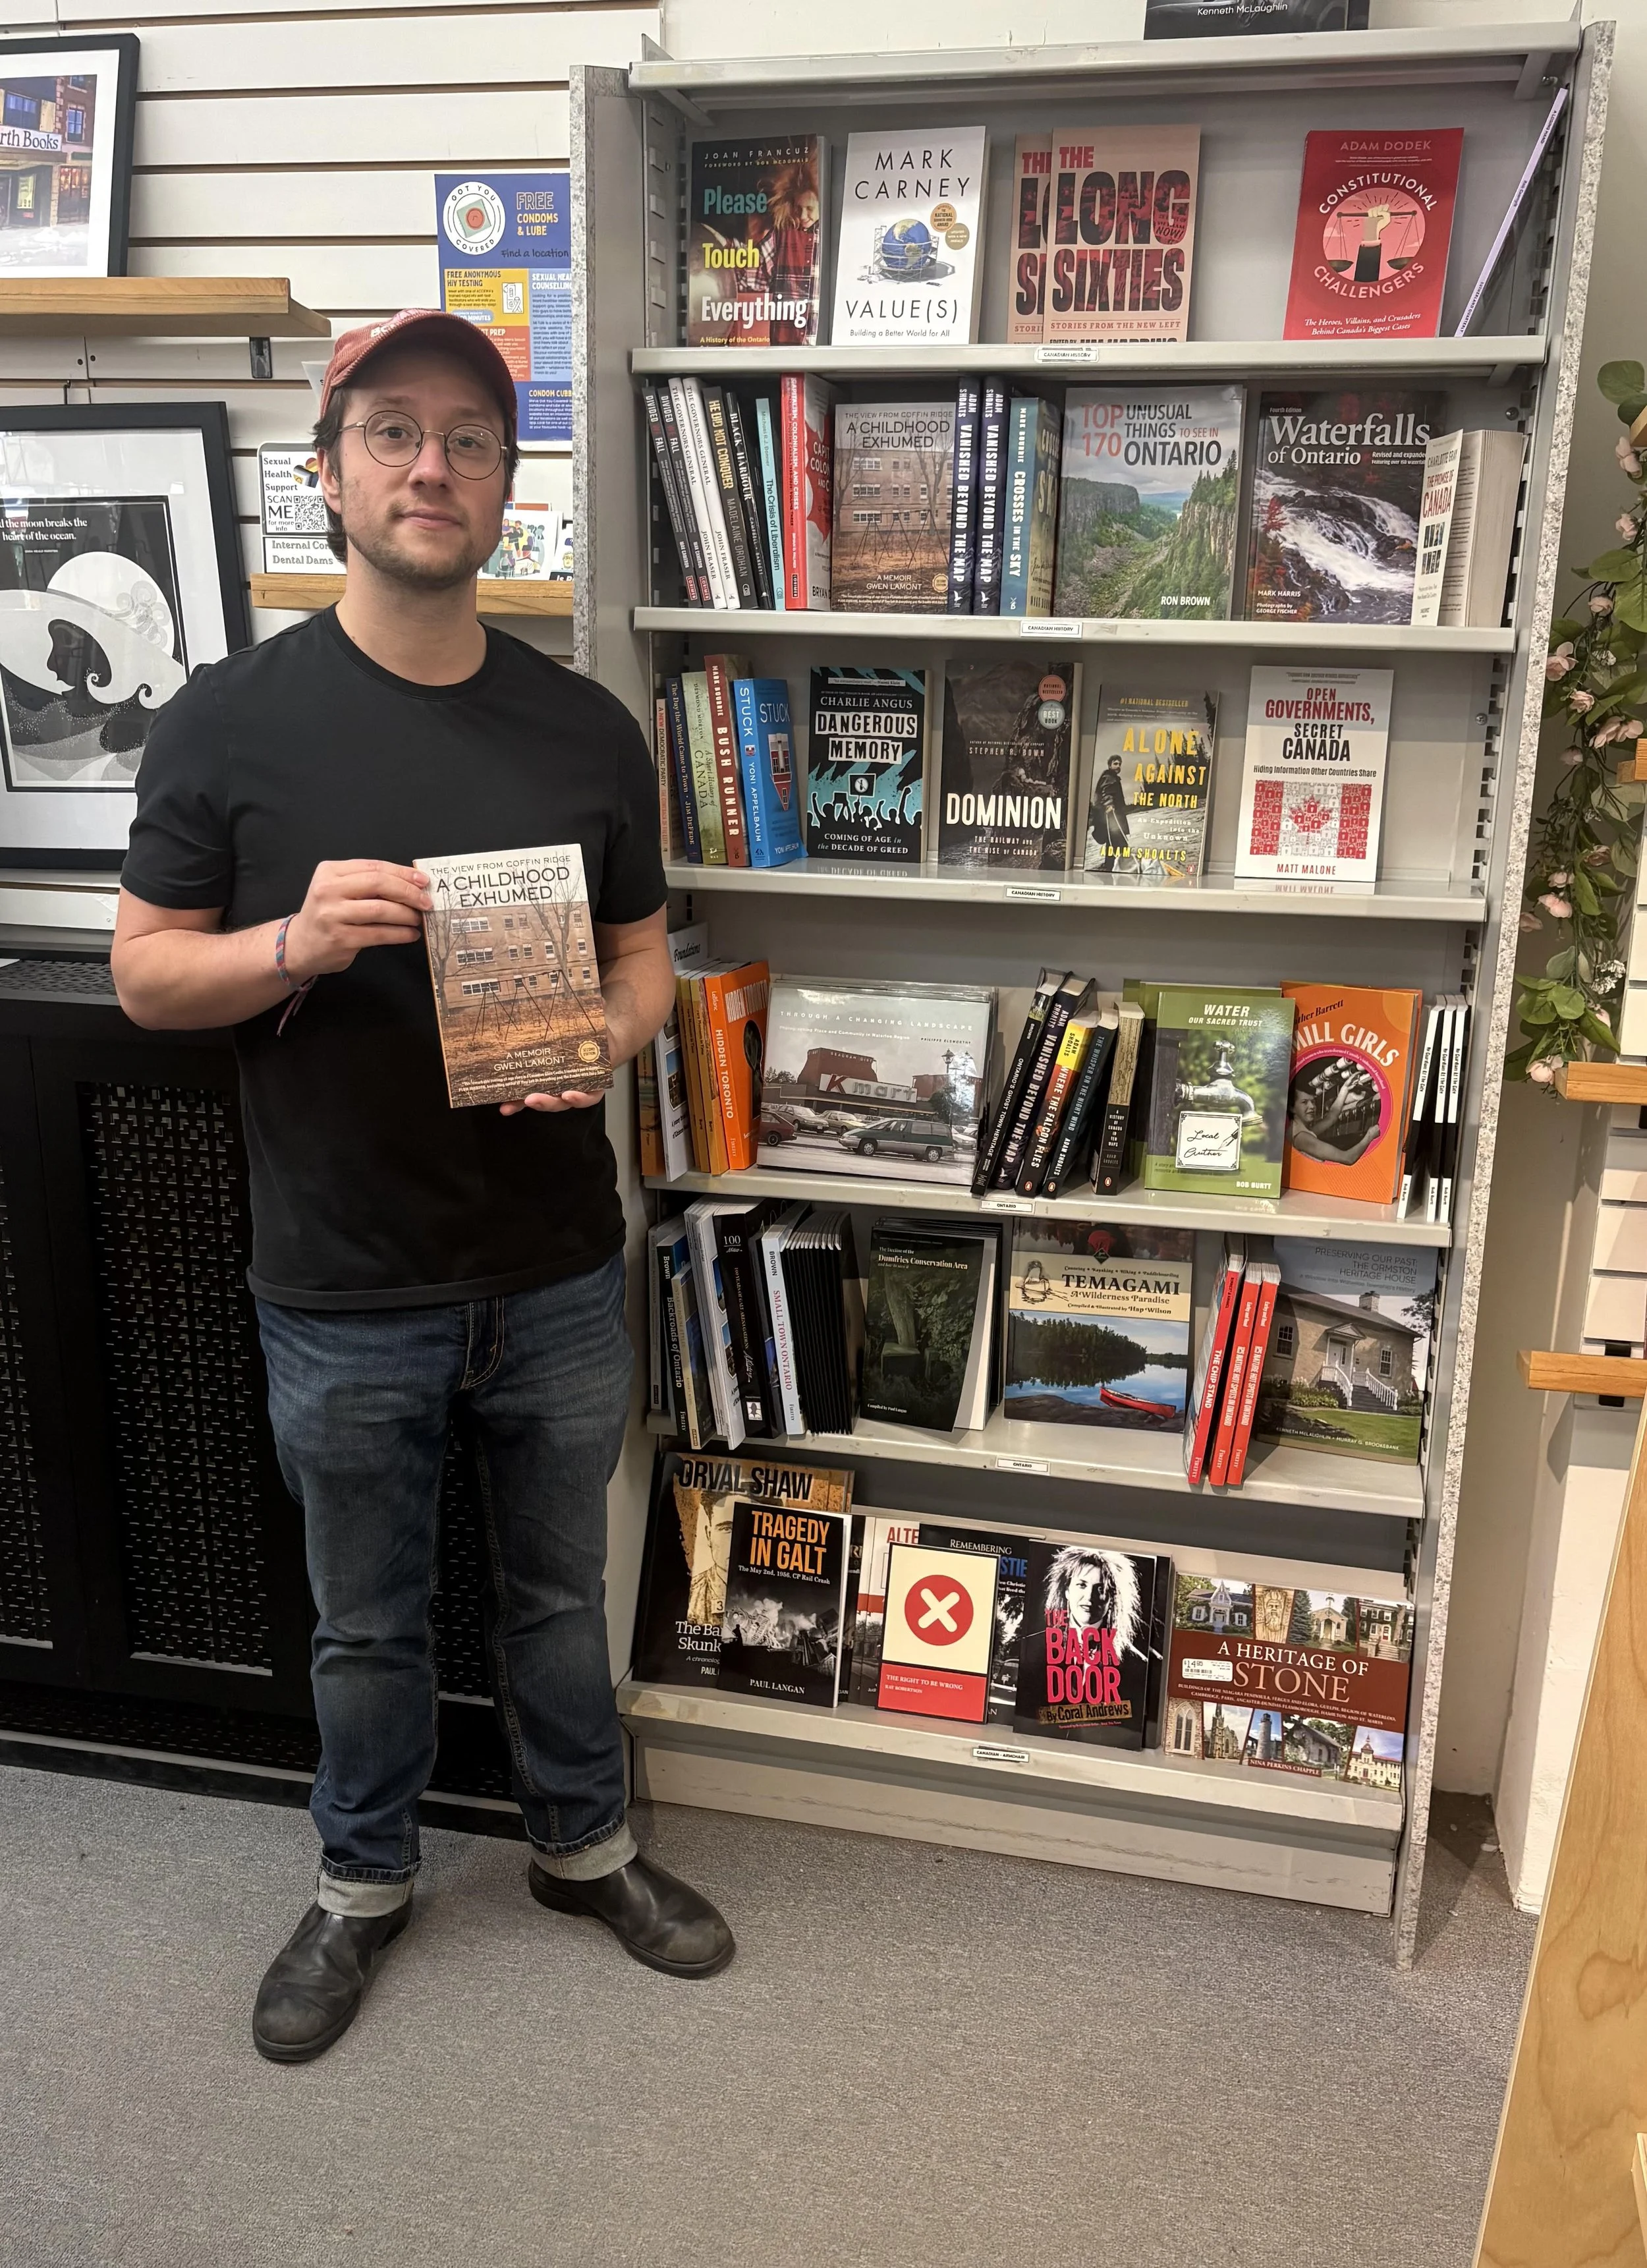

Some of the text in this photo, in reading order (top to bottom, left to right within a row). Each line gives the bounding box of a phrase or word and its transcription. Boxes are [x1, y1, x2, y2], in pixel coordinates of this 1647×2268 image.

[1198, 3, 1287, 16] Kenneth McLaughlin
[0, 130, 59, 150] rth Books
[1341, 140, 1431, 150] ADAM DODEK
[705, 147, 809, 160] JOAN FRANCUZ
[876, 149, 953, 171] MARK
[1059, 146, 1094, 168] THE
[452, 186, 496, 202] GOT YOU
[855, 178, 970, 200] CARNEY
[1319, 173, 1438, 214] CONSTITUTIONAL
[516, 192, 554, 210] FREE
[703, 186, 767, 215] Please
[1054, 171, 1190, 245] LONG
[517, 213, 558, 223] CONDOMS
[517, 226, 547, 235] & LUBE
[456, 239, 495, 252] COVERED
[501, 250, 522, 258] Find
[532, 249, 569, 258] location
[702, 240, 760, 268] Touch
[1052, 248, 1185, 312] SIXTIES
[1314, 262, 1424, 298] CHALLENGERS
[702, 294, 808, 328] Everything
[846, 300, 959, 324] VALUE(S)
[1082, 403, 1123, 429] TOP
[1126, 404, 1192, 420] UNUSUAL
[1125, 422, 1218, 438] THINGS TO SEE IN
[1269, 413, 1431, 446] Waterfalls
[690, 403, 704, 449] GOVERNORS
[700, 450, 712, 485] GENERAL
[1083, 432, 1121, 457] 170
[1124, 441, 1221, 466] ONTARIO
[1268, 447, 1361, 464] of Ontario
[265, 484, 298, 492] Support
[269, 506, 293, 519] ME
[954, 424, 972, 582] VANISHED BEYOND THE MAP
[5, 519, 19, 528] the
[45, 518, 72, 527] breaks
[74, 517, 87, 526] the
[3, 532, 25, 540] heart
[26, 531, 34, 540] of
[35, 531, 49, 540] the
[272, 540, 310, 550] Internal
[727, 498, 748, 577] MADELAINE DROHAN
[306, 555, 333, 565] Dams
[715, 531, 731, 580] JOHN FRASER
[1161, 596, 1210, 606] RON BROWN
[820, 696, 912, 708] CHARLIE ANGUS
[1306, 688, 1336, 701] OPEN
[740, 688, 753, 737] STUCK
[1265, 700, 1375, 725] GOVERNMENTS,
[818, 714, 916, 735] DANGEROUS
[1294, 723, 1343, 739] SECRET
[831, 740, 902, 761] MEMORY
[1123, 727, 1199, 755] ALONE
[1283, 737, 1350, 761] CANADA
[717, 727, 739, 836] BUSH RUNNER
[1134, 764, 1206, 785] AGAINST
[946, 793, 1061, 829] DOMINION
[1134, 793, 1197, 808] THE NORTH
[751, 787, 761, 841] APPELBAUM
[507, 859, 540, 867] COFFIN
[1101, 845, 1186, 861] ADAM SHOALTS
[437, 866, 570, 893] A CHILDHOOD
[1277, 863, 1336, 875] MATT MALONE
[460, 886, 553, 907] EXHUMED
[1204, 1004, 1250, 1017] WATER
[515, 1048, 551, 1058] MEMOIR
[1341, 1023, 1399, 1067] GIRLS
[493, 1056, 565, 1071] GWEN LAMONT
[715, 1029, 733, 1119] HIDDEN TORONTO
[1031, 1065, 1069, 1168] WHERE THE FALCON FLIES
[1062, 1274, 1179, 1295] TEMAGAMI
[773, 1290, 784, 1321] SMALL
[777, 1320, 789, 1349] TOWN
[781, 1349, 793, 1391] ONTARIO
[1205, 1383, 1216, 1409] STAND
[679, 1460, 812, 1501] ORVAL SHAW
[752, 1511, 830, 1545] TRAGEDY
[750, 1537, 827, 1574] IN GALT
[950, 1539, 1012, 1554] REMEMBERING
[1046, 1628, 1120, 1666] BACK
[1217, 1641, 1232, 1655] A
[1237, 1644, 1335, 1671] HERITAGE
[1341, 1659, 1368, 1676] OF
[750, 1679, 804, 1694] PAUL LANGAN
[1047, 1665, 1121, 1704] DOOR
[1233, 1662, 1350, 1703] STONE
